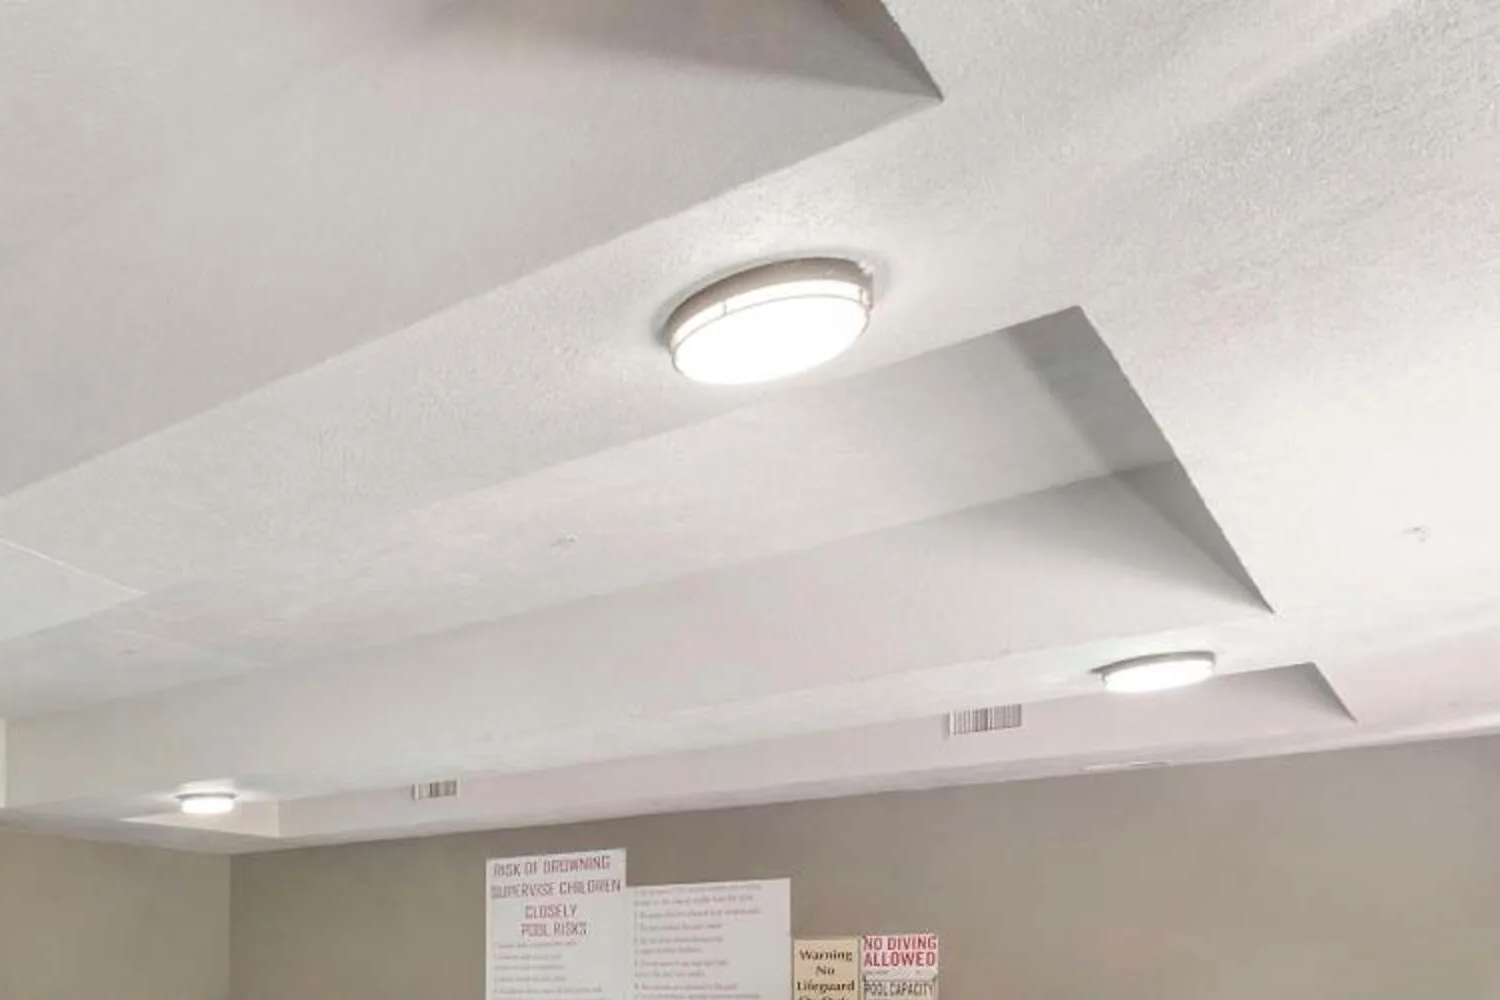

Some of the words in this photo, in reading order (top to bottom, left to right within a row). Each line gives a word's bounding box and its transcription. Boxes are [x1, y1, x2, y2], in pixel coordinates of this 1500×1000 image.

[494, 863, 520, 877] RISK
[543, 856, 611, 875] DROWNING
[491, 881, 556, 899] SUPERVISE
[560, 879, 621, 896] CHILDREN
[525, 904, 578, 919] CLOSELY
[553, 922, 587, 936] RISKS
[864, 937, 883, 951] NO
[887, 935, 937, 950] DIVING
[800, 949, 853, 962] Warning
[863, 951, 935, 967] ALLOWED
[816, 965, 835, 976] No
[797, 980, 855, 993] Lifeguard
[890, 981, 933, 997] CAPACITY
